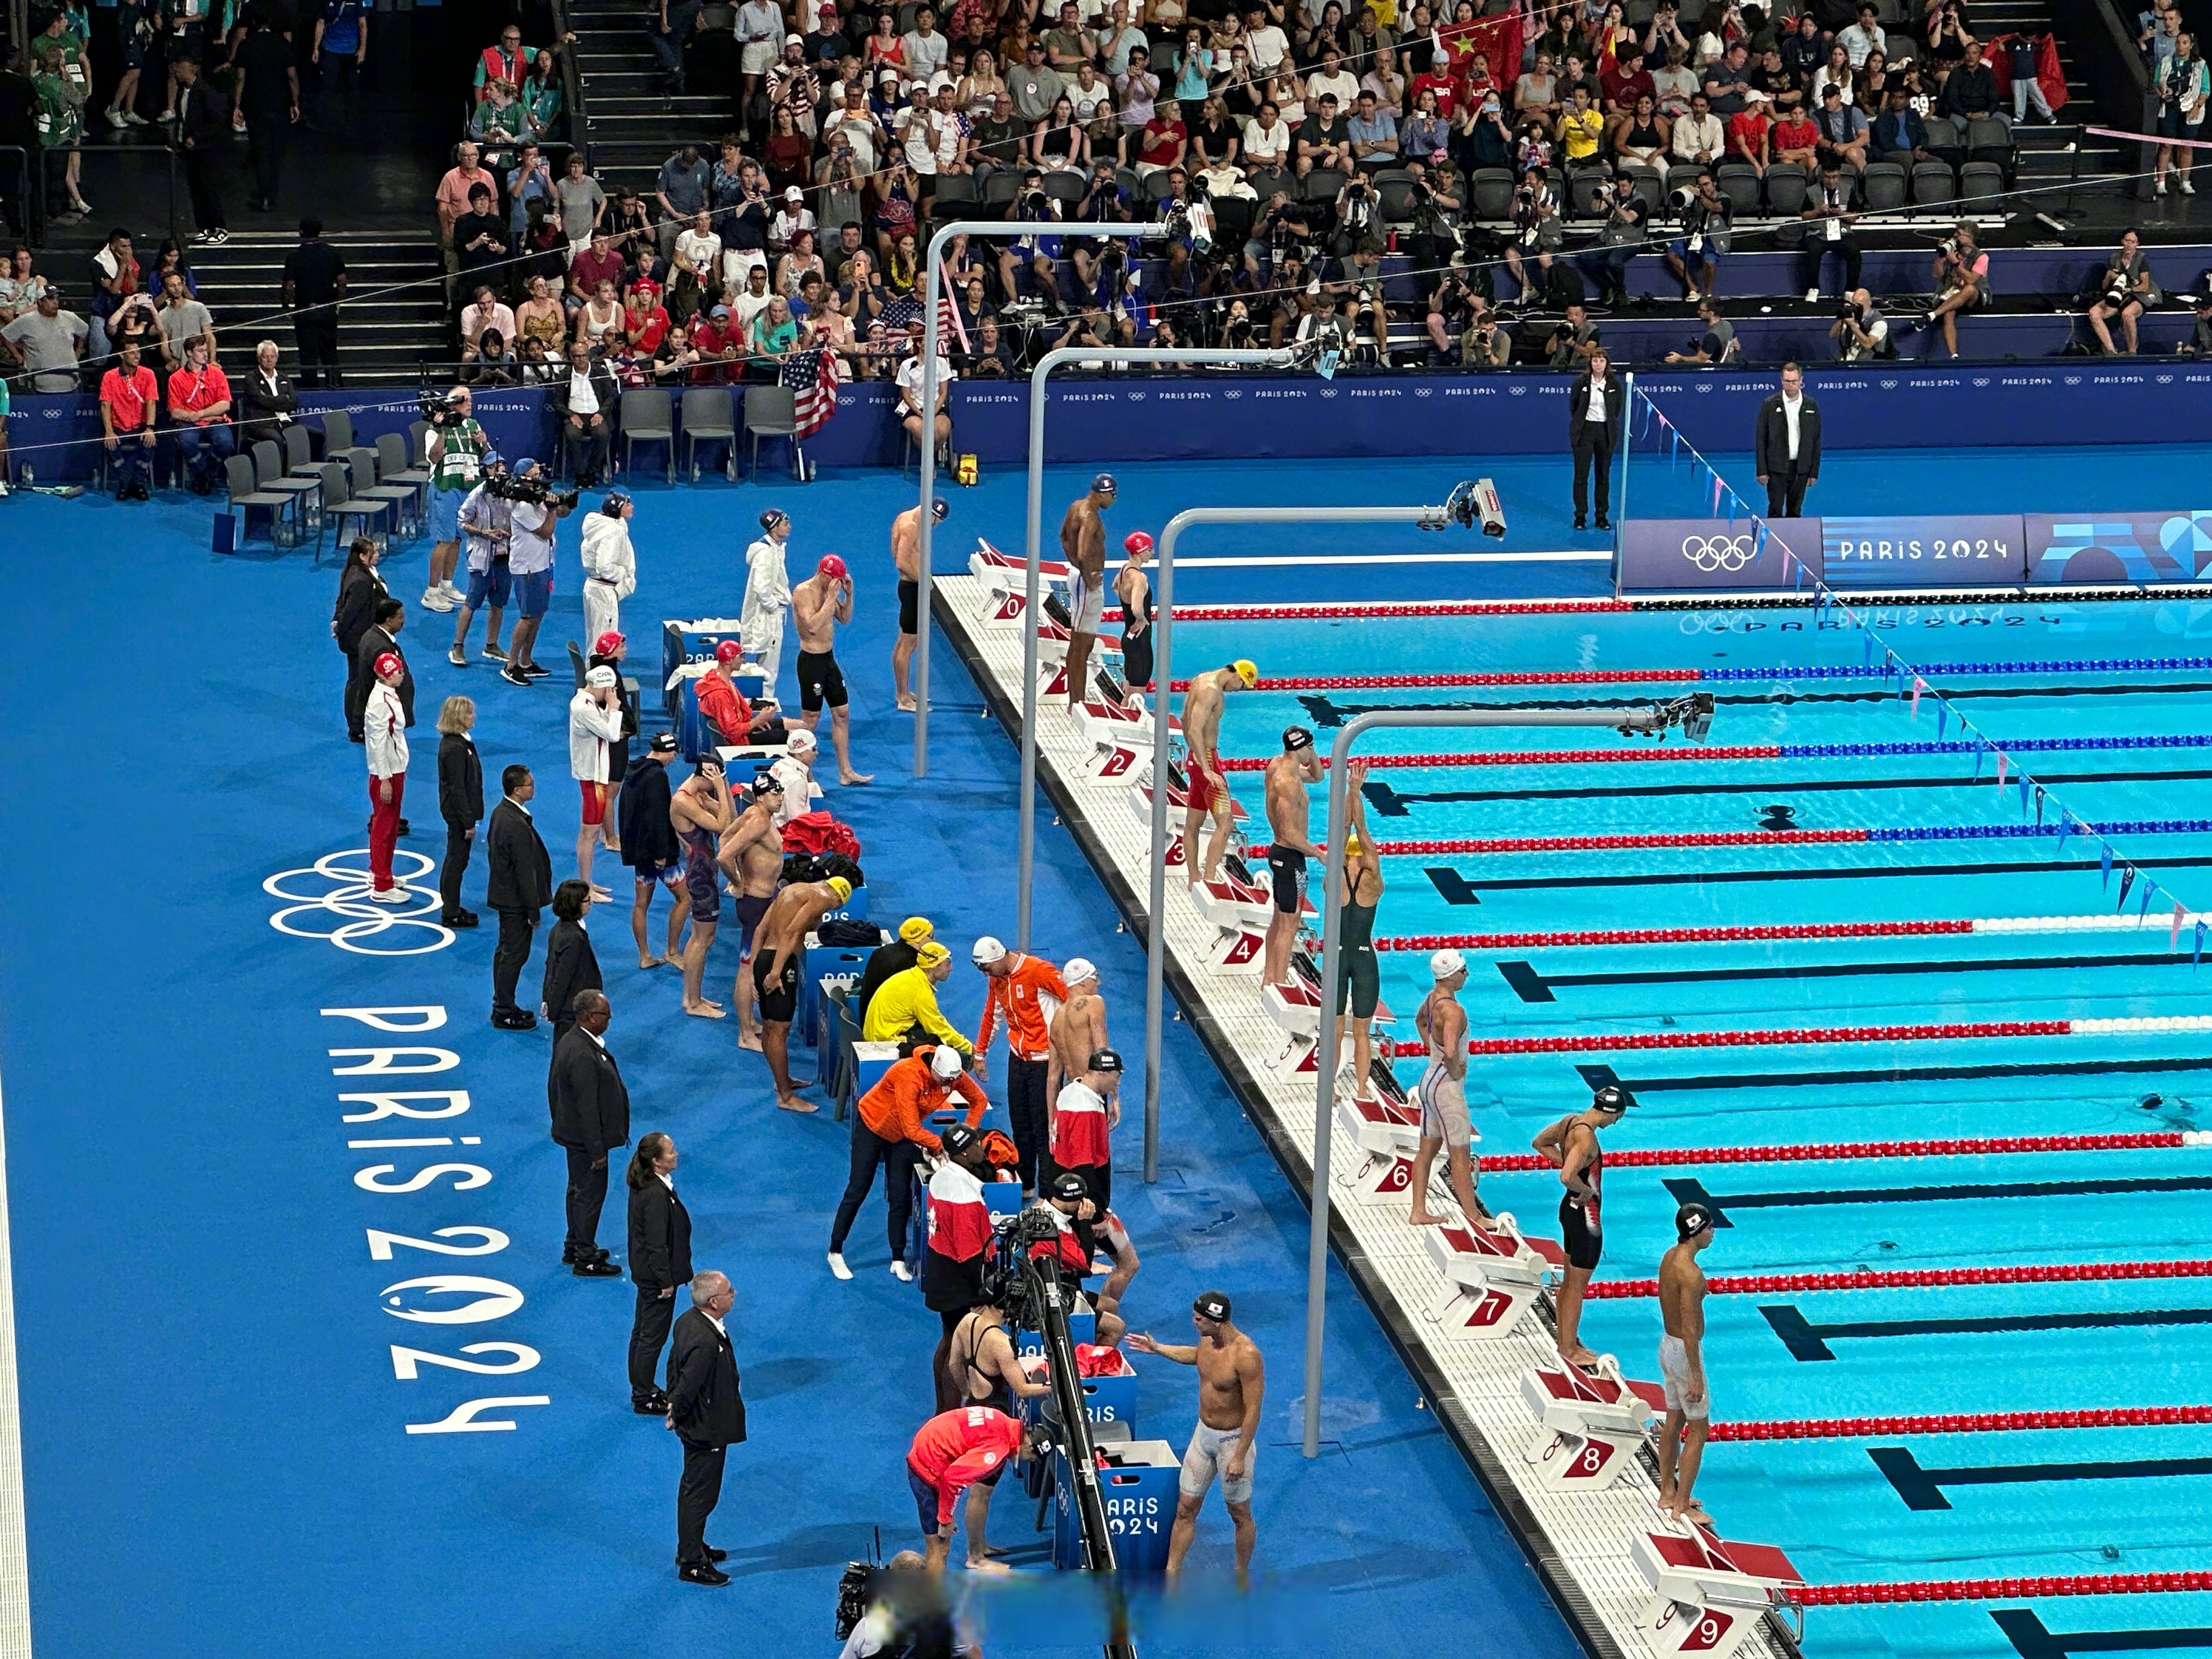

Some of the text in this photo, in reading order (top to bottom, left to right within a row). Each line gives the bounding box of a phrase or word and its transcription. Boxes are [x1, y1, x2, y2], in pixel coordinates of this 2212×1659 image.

[1934, 539, 2008, 560] 2024
[1007, 599, 1019, 616] 0
[1923, 616, 2061, 630] 2024
[1112, 755, 1125, 772] 2
[1173, 843, 1186, 862] 3
[1236, 940, 1250, 960] 4
[1279, 1037, 1298, 1061] 5
[1357, 1154, 1376, 1179] 6
[1393, 1165, 1406, 1186] 6
[1484, 1298, 1499, 1320] 7
[366, 1225, 551, 1435] 2024
[1542, 1433, 1564, 1461] 8
[1584, 1447, 1600, 1471] 8
[1109, 1517, 1159, 1535] 024
[1655, 1601, 1679, 1630] 9
[1701, 1619, 1718, 1644] 9
